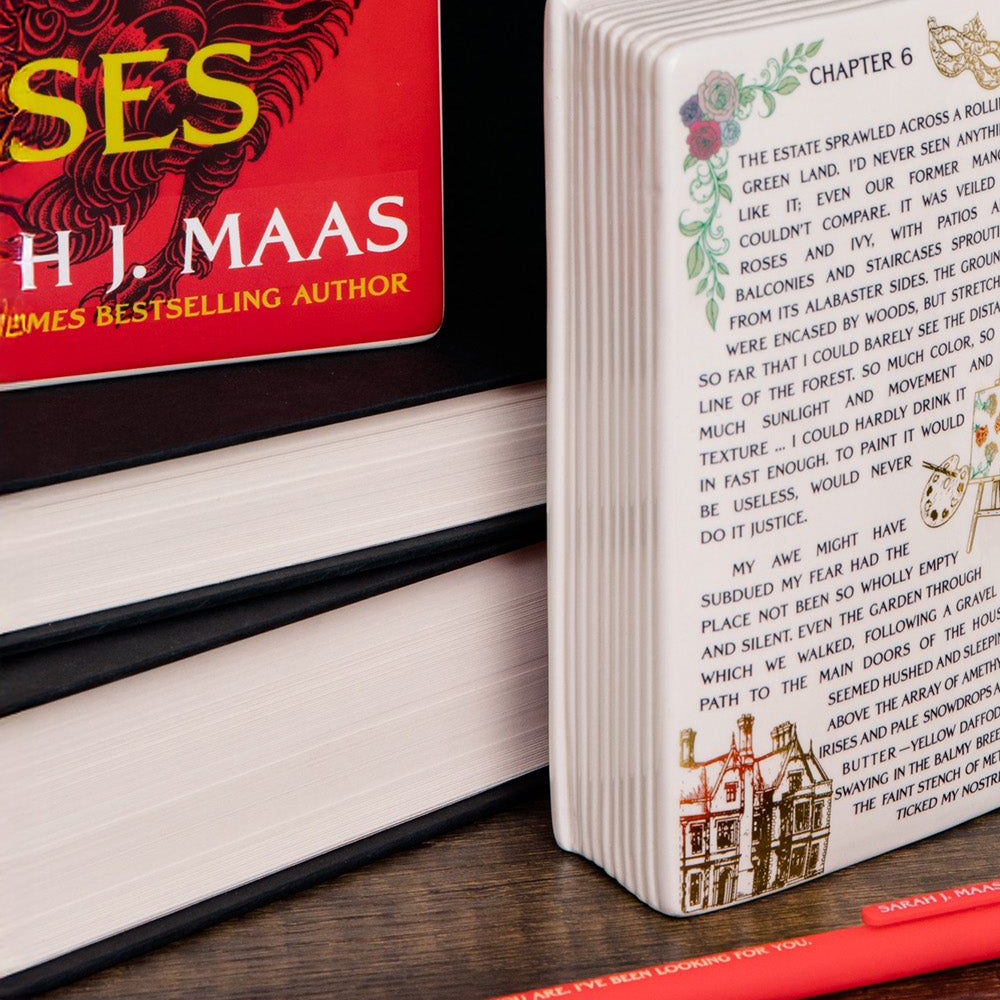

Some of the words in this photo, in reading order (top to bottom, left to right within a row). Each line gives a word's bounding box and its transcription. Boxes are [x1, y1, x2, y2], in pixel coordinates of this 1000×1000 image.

[809, 51, 895, 86] CHAPTER
[900, 46, 914, 66] 6
[738, 149, 769, 169] THE
[772, 138, 822, 163] ESTATE
[824, 122, 897, 152] SPRAWLED
[899, 109, 951, 136] ACROSS
[952, 107, 963, 123] A
[106, 225, 147, 294] J.
[180, 195, 408, 274] MAAS
[740, 252, 788, 275] ROSES
[804, 242, 835, 262] AND
[850, 233, 875, 252] IVY,
[890, 221, 923, 241] WITH
[937, 205, 978, 230] PATIOS
[96, 287, 281, 327] BESTSELLING
[291, 272, 411, 306] AUTHOR
[735, 272, 816, 303] BALCONIES
[825, 263, 856, 284] AND
[865, 241, 943, 274] STAIRCASES
[725, 336, 768, 357] WERE
[773, 320, 838, 348] ENCASED
[842, 314, 860, 332] BY
[864, 300, 919, 325] WOODS,
[923, 290, 947, 311] BUT
[699, 419, 746, 441] MUCH
[761, 399, 831, 430] SUNLIGHT
[844, 388, 875, 409] AND
[887, 363, 958, 398] MOVEMENT
[968, 352, 994, 374] AND
[699, 502, 720, 519] BE
[733, 486, 799, 513] USELESS,
[809, 469, 861, 495] WOULD
[870, 454, 913, 479] NEVER
[731, 559, 756, 578] MY
[771, 548, 802, 569] AWE
[816, 532, 858, 556] MIGHT
[872, 518, 907, 541] HAVE
[700, 641, 737, 661] AND
[740, 628, 794, 653] SILENT.
[797, 616, 833, 640] EVEN
[838, 606, 865, 627] THE
[868, 587, 923, 617] GARDEN
[925, 566, 982, 599] THROUGH
[827, 678, 880, 706] SEEMED
[882, 659, 934, 689] HUSHED
[935, 649, 962, 670] AND
[827, 706, 870, 732] ABOVE
[874, 696, 899, 716] THE
[900, 680, 942, 708] ARRAY
[943, 673, 960, 691] OF
[878, 895, 937, 914] SARAH
[939, 893, 952, 903] J.
[573, 979, 607, 993] I'VE
[610, 970, 652, 986] BEEN
[654, 955, 732, 976] LOOKING
[733, 946, 769, 961] FOR
[771, 938, 812, 952] YOU.
